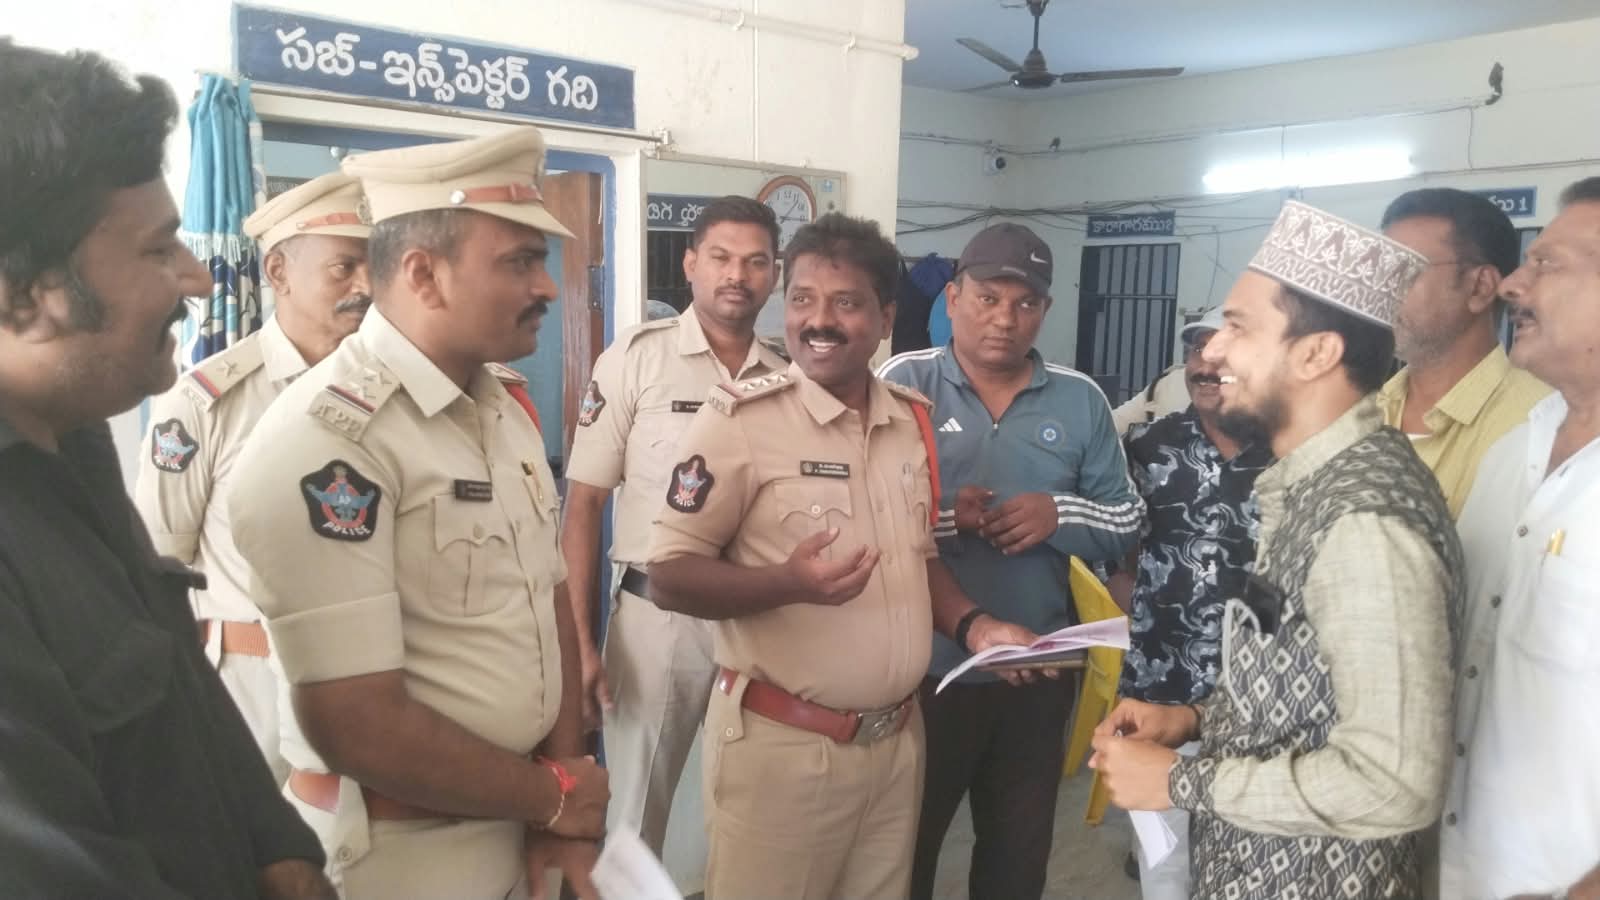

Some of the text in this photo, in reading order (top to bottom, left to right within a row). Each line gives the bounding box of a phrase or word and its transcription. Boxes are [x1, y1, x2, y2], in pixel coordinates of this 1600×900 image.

[545, 65, 599, 111] గది
[1519, 196, 1528, 211] 1
[322, 521, 371, 536] POLICE
